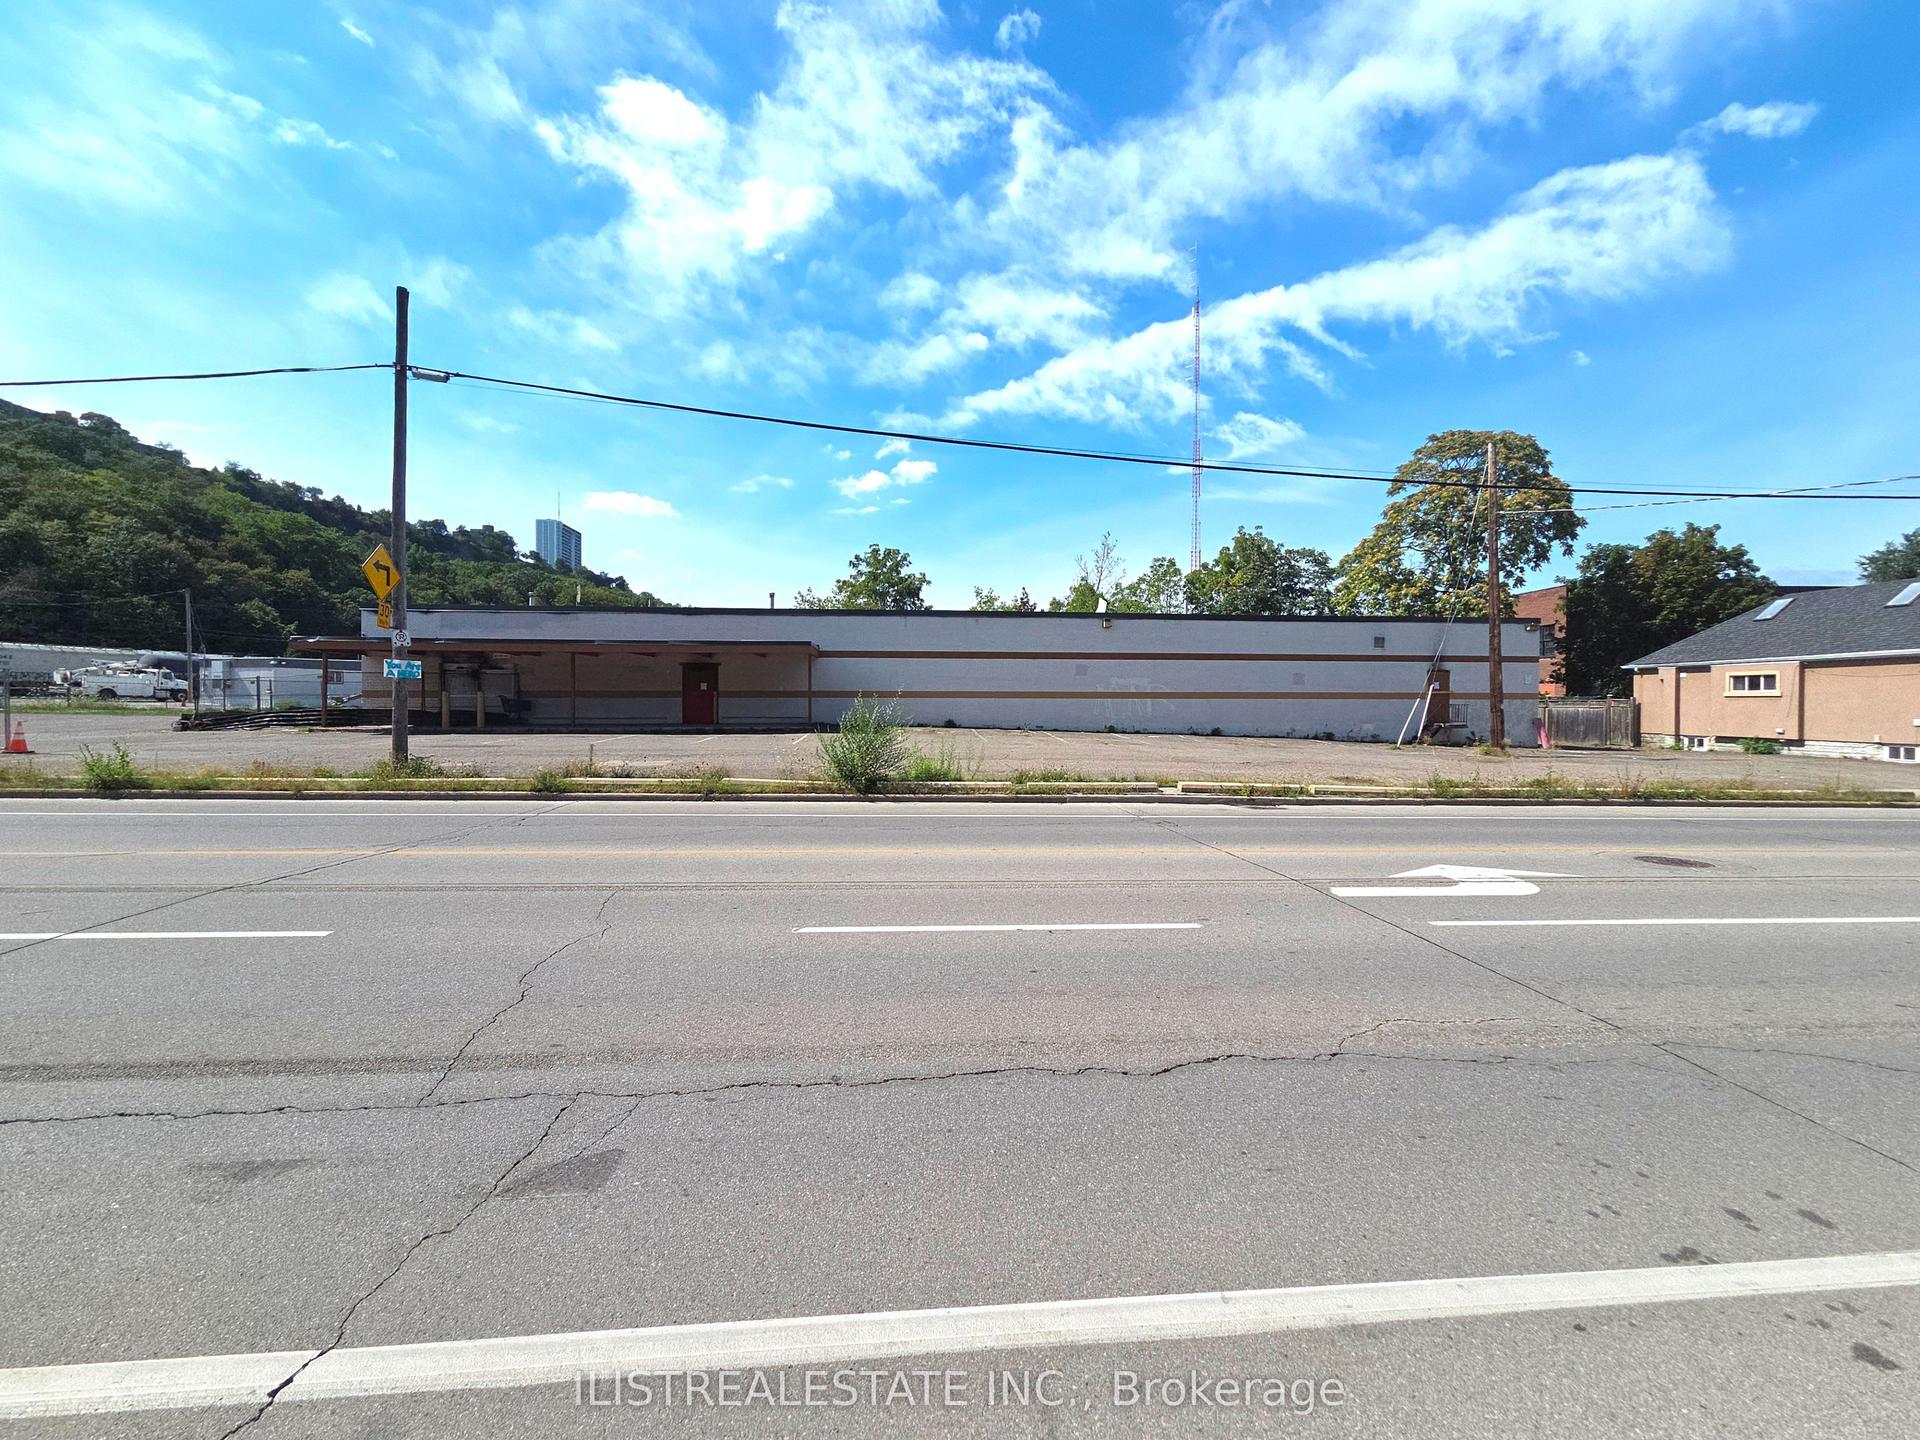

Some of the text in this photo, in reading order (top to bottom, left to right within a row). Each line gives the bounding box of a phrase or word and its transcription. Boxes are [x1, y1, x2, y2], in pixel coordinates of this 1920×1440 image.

[380, 604, 389, 618] 30
[385, 660, 421, 670] You Are
